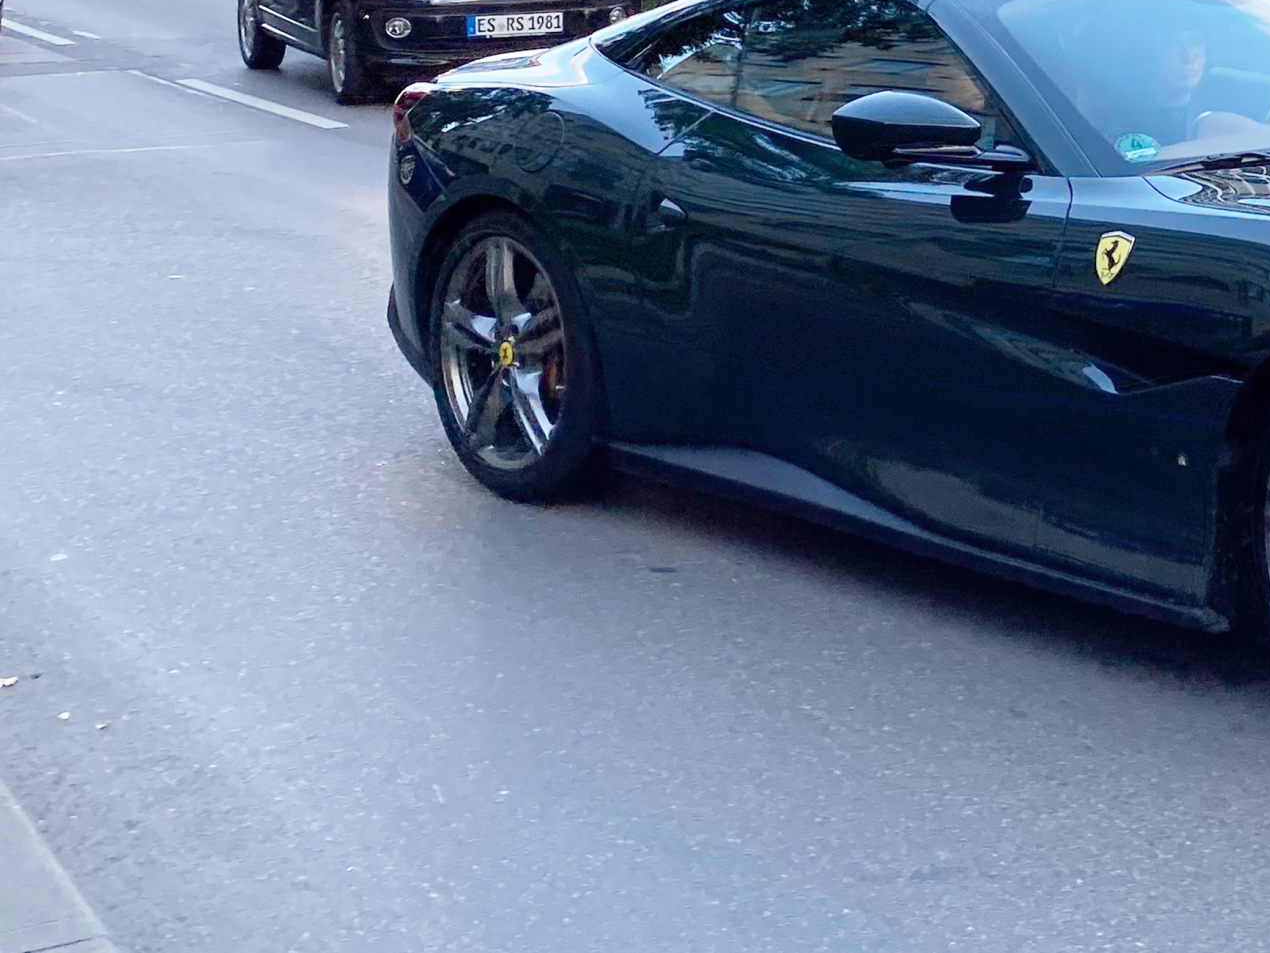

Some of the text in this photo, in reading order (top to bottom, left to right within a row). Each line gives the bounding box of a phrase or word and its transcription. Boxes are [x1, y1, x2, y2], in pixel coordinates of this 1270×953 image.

[477, 14, 562, 34] ES RS 1981
